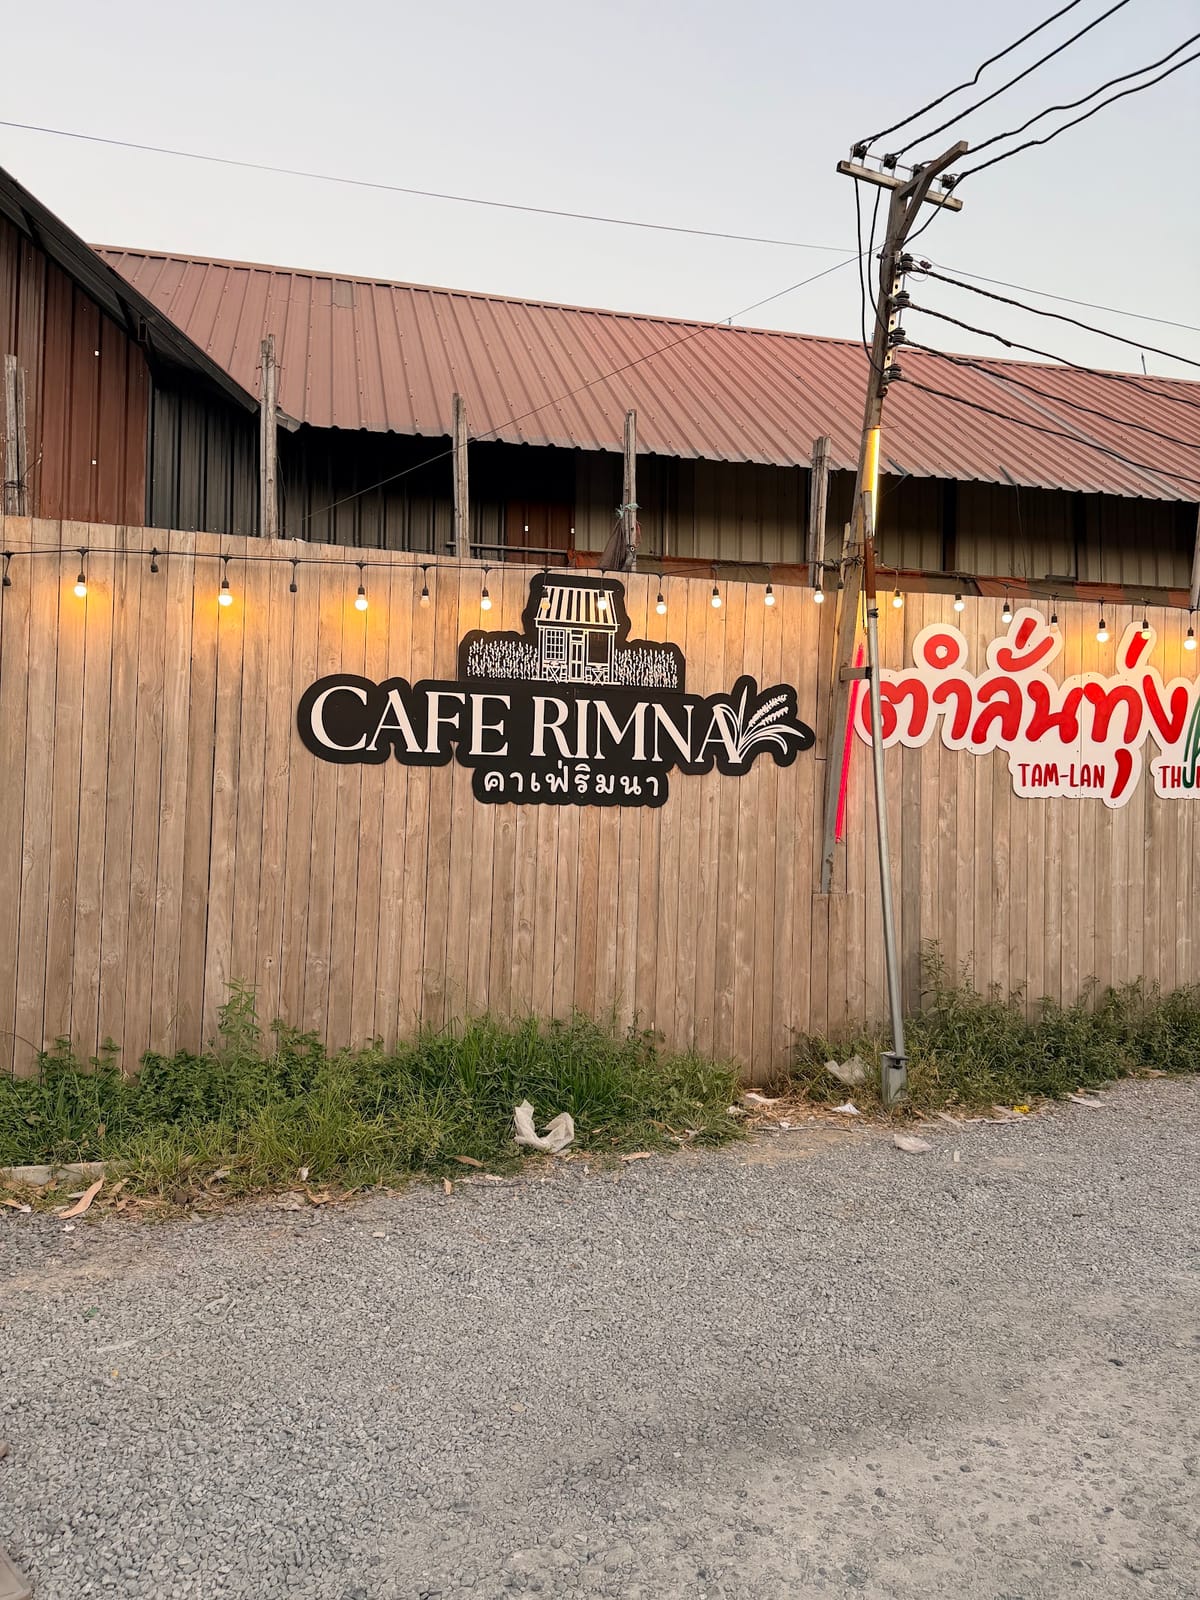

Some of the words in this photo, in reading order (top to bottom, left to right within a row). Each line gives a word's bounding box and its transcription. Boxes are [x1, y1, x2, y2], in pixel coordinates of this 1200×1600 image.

[310, 685, 512, 757] CAFE
[530, 695, 744, 765] RIMNA
[484, 759, 659, 797] คาเฟ่ริมนา
[1017, 763, 1105, 789] TAM-LAN
